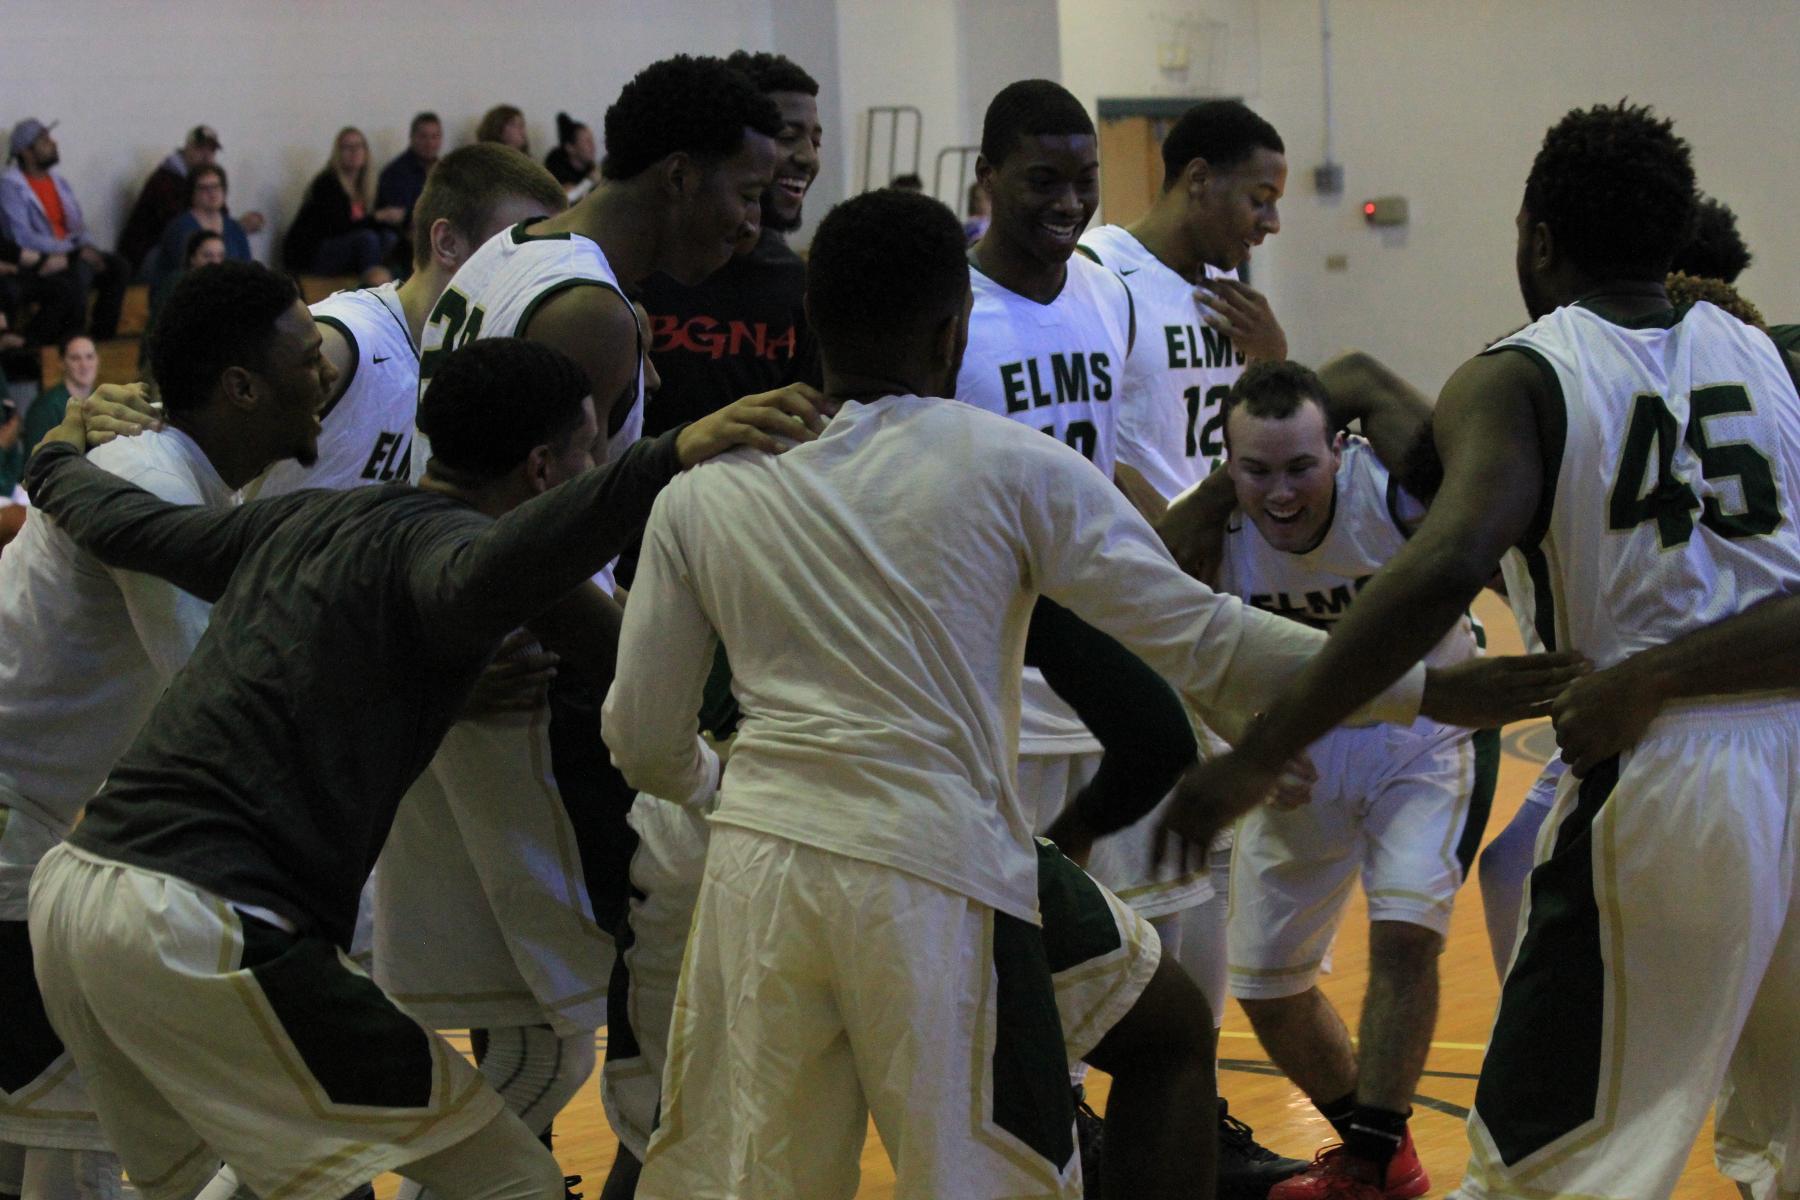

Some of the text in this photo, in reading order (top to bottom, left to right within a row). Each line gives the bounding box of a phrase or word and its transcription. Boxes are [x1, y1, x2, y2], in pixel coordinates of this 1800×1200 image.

[1000, 352, 1112, 413] ELMS
[1184, 385, 1232, 457] 12
[1608, 383, 1783, 552] 45
